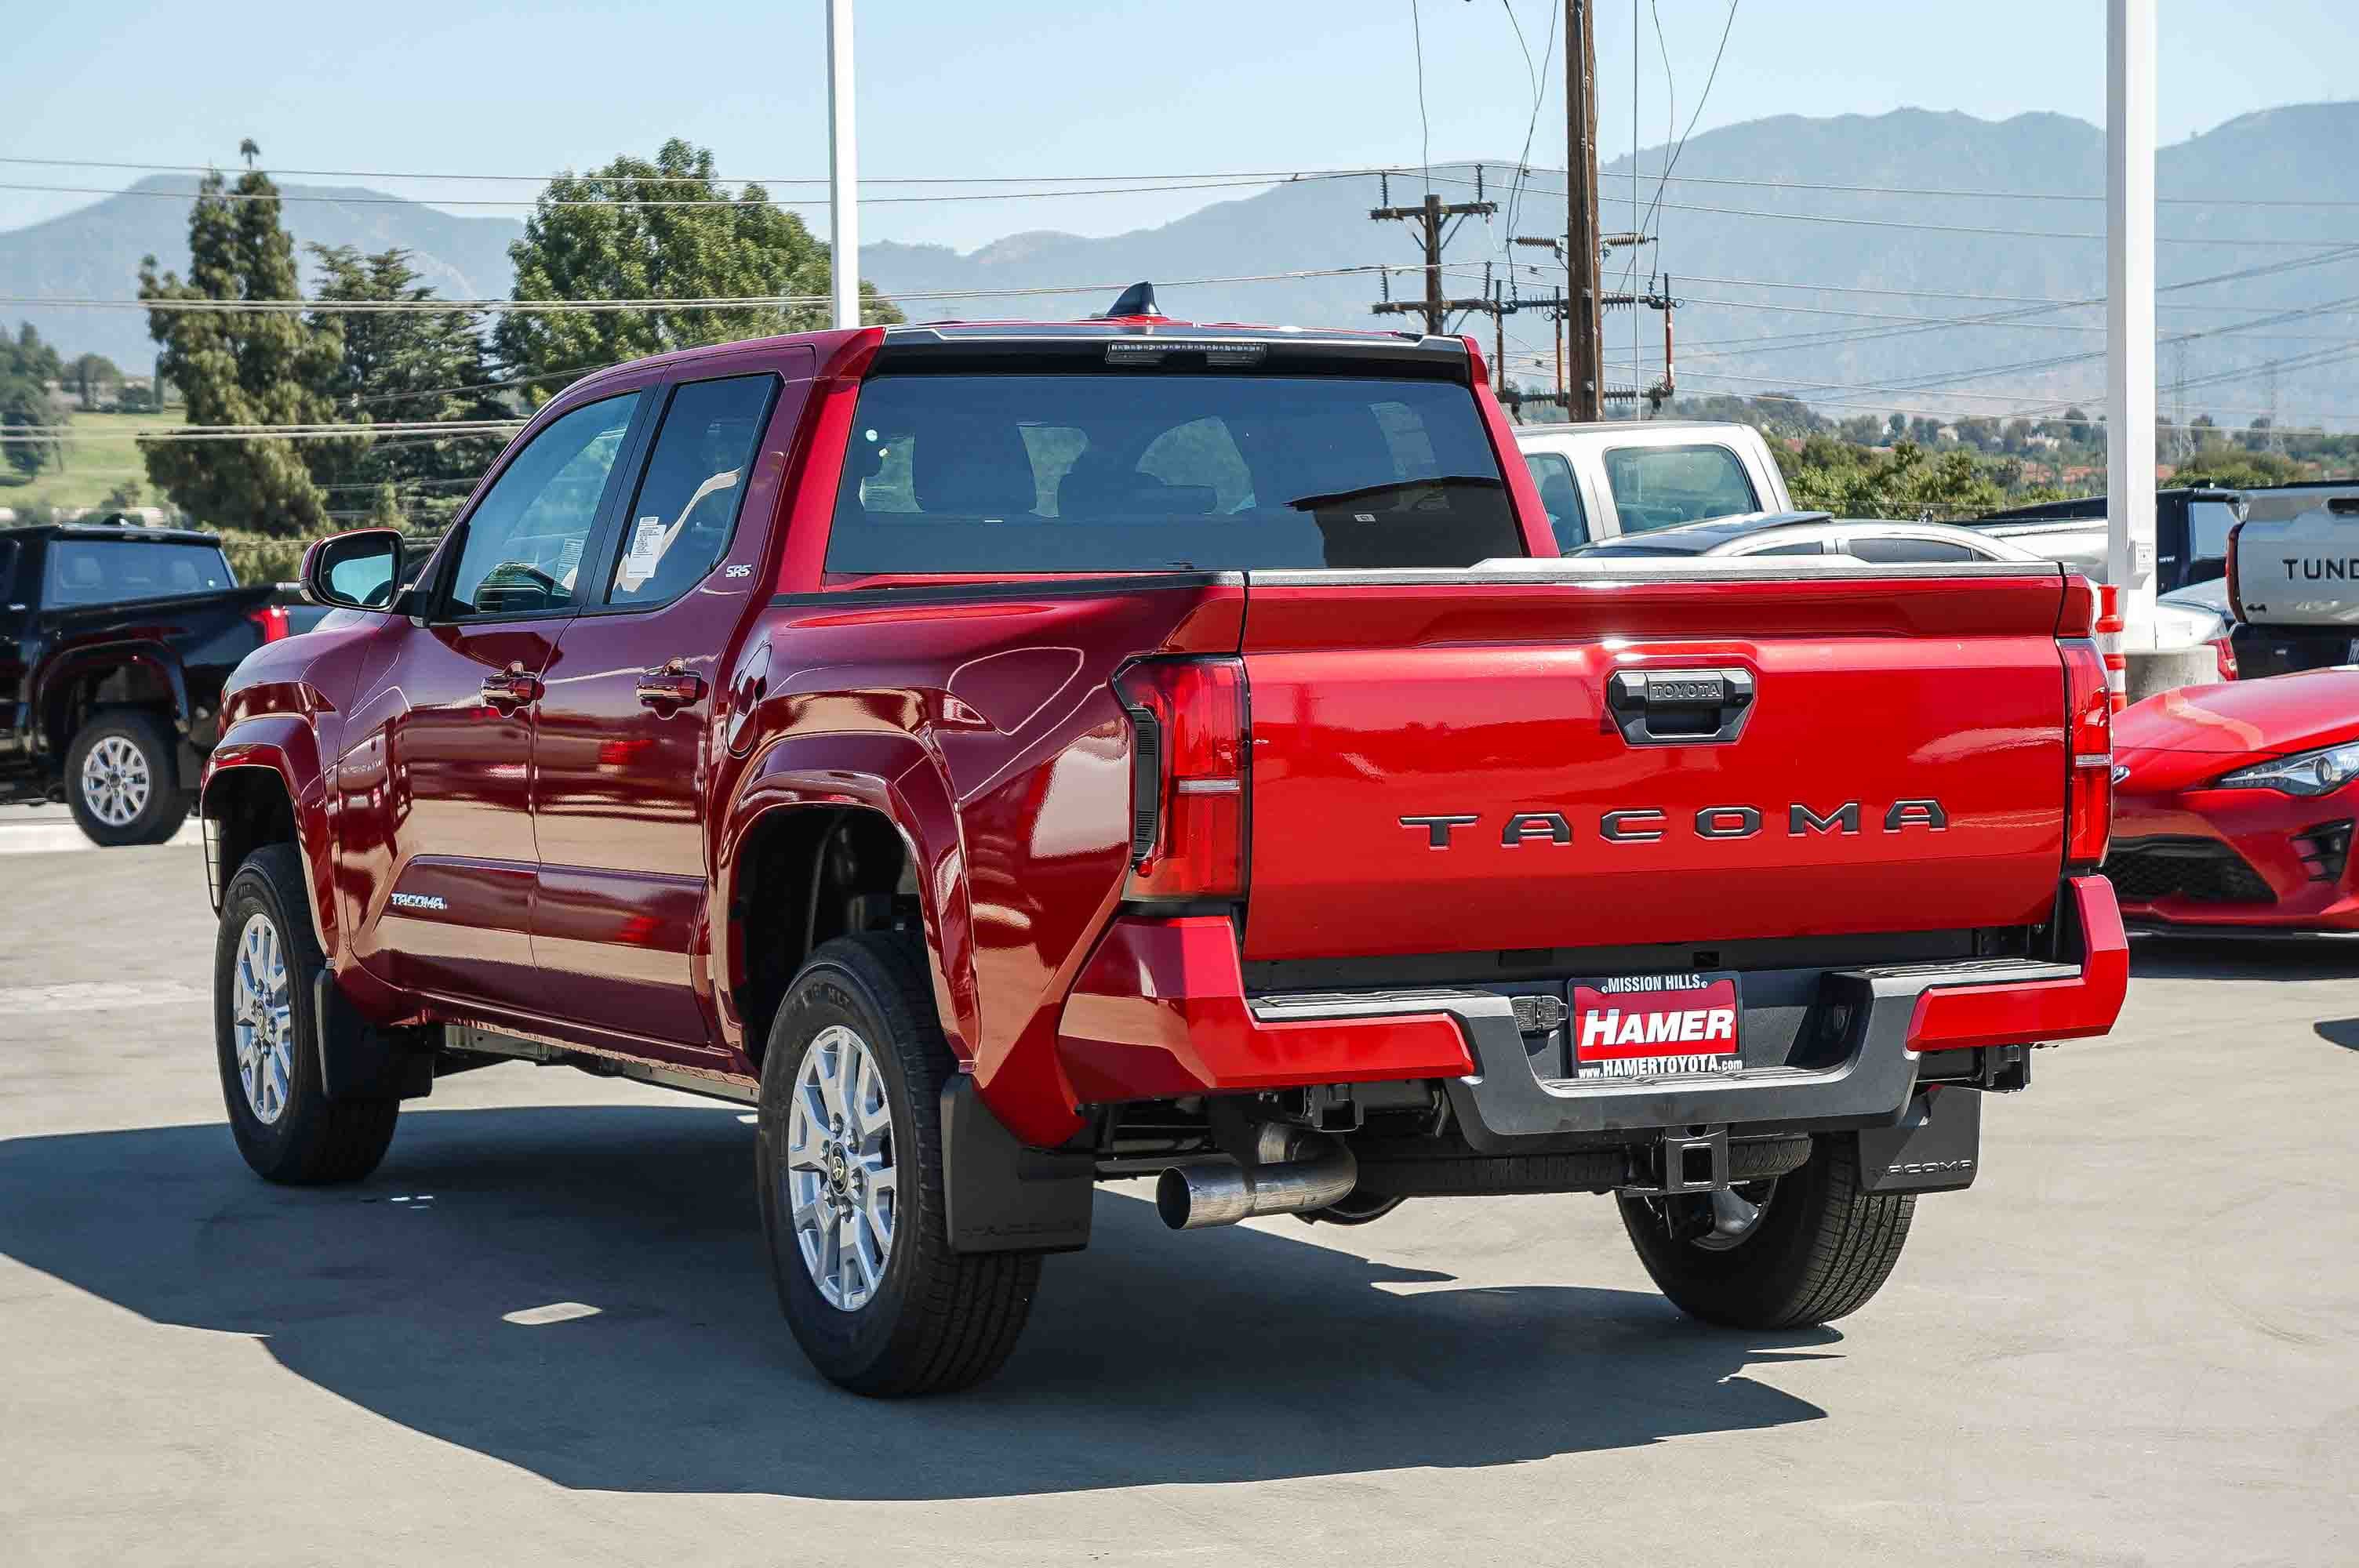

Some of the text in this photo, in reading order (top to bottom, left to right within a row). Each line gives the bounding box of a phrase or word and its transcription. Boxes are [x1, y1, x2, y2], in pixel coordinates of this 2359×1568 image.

[1652, 683, 1721, 698] TOYOTA
[1399, 797, 1949, 850] TACOMA
[391, 892, 447, 909] TACOMA
[1607, 974, 1701, 993] MISSION HILLS
[1581, 1008, 1736, 1047] HAMER
[1578, 1054, 1743, 1079] www.HAMERTOYOTA.com
